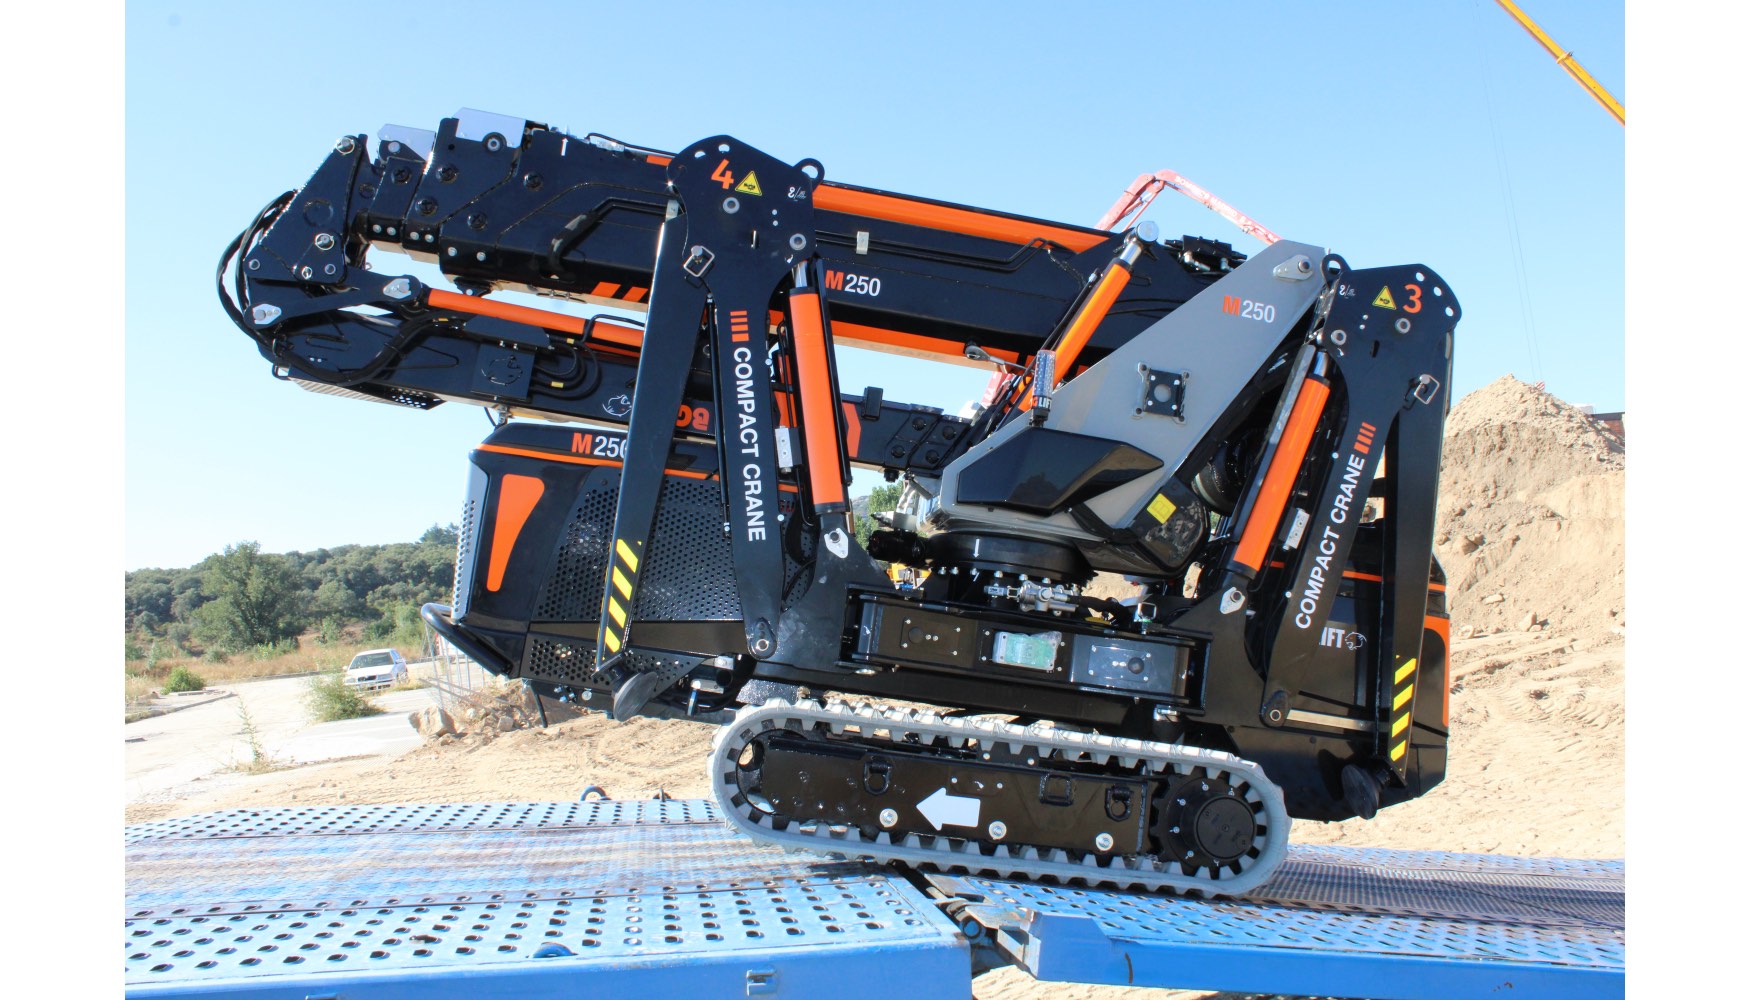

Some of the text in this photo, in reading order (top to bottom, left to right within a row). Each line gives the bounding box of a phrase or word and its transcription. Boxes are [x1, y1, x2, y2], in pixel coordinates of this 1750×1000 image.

[710, 158, 735, 190] 4
[825, 269, 881, 297] M250
[1402, 283, 1423, 314] 3
[1222, 295, 1276, 324] M250
[733, 346, 767, 542] COMPACT CRANE
[1295, 453, 1366, 630] COMPACT CRANE
[1319, 626, 1346, 649] IFT
